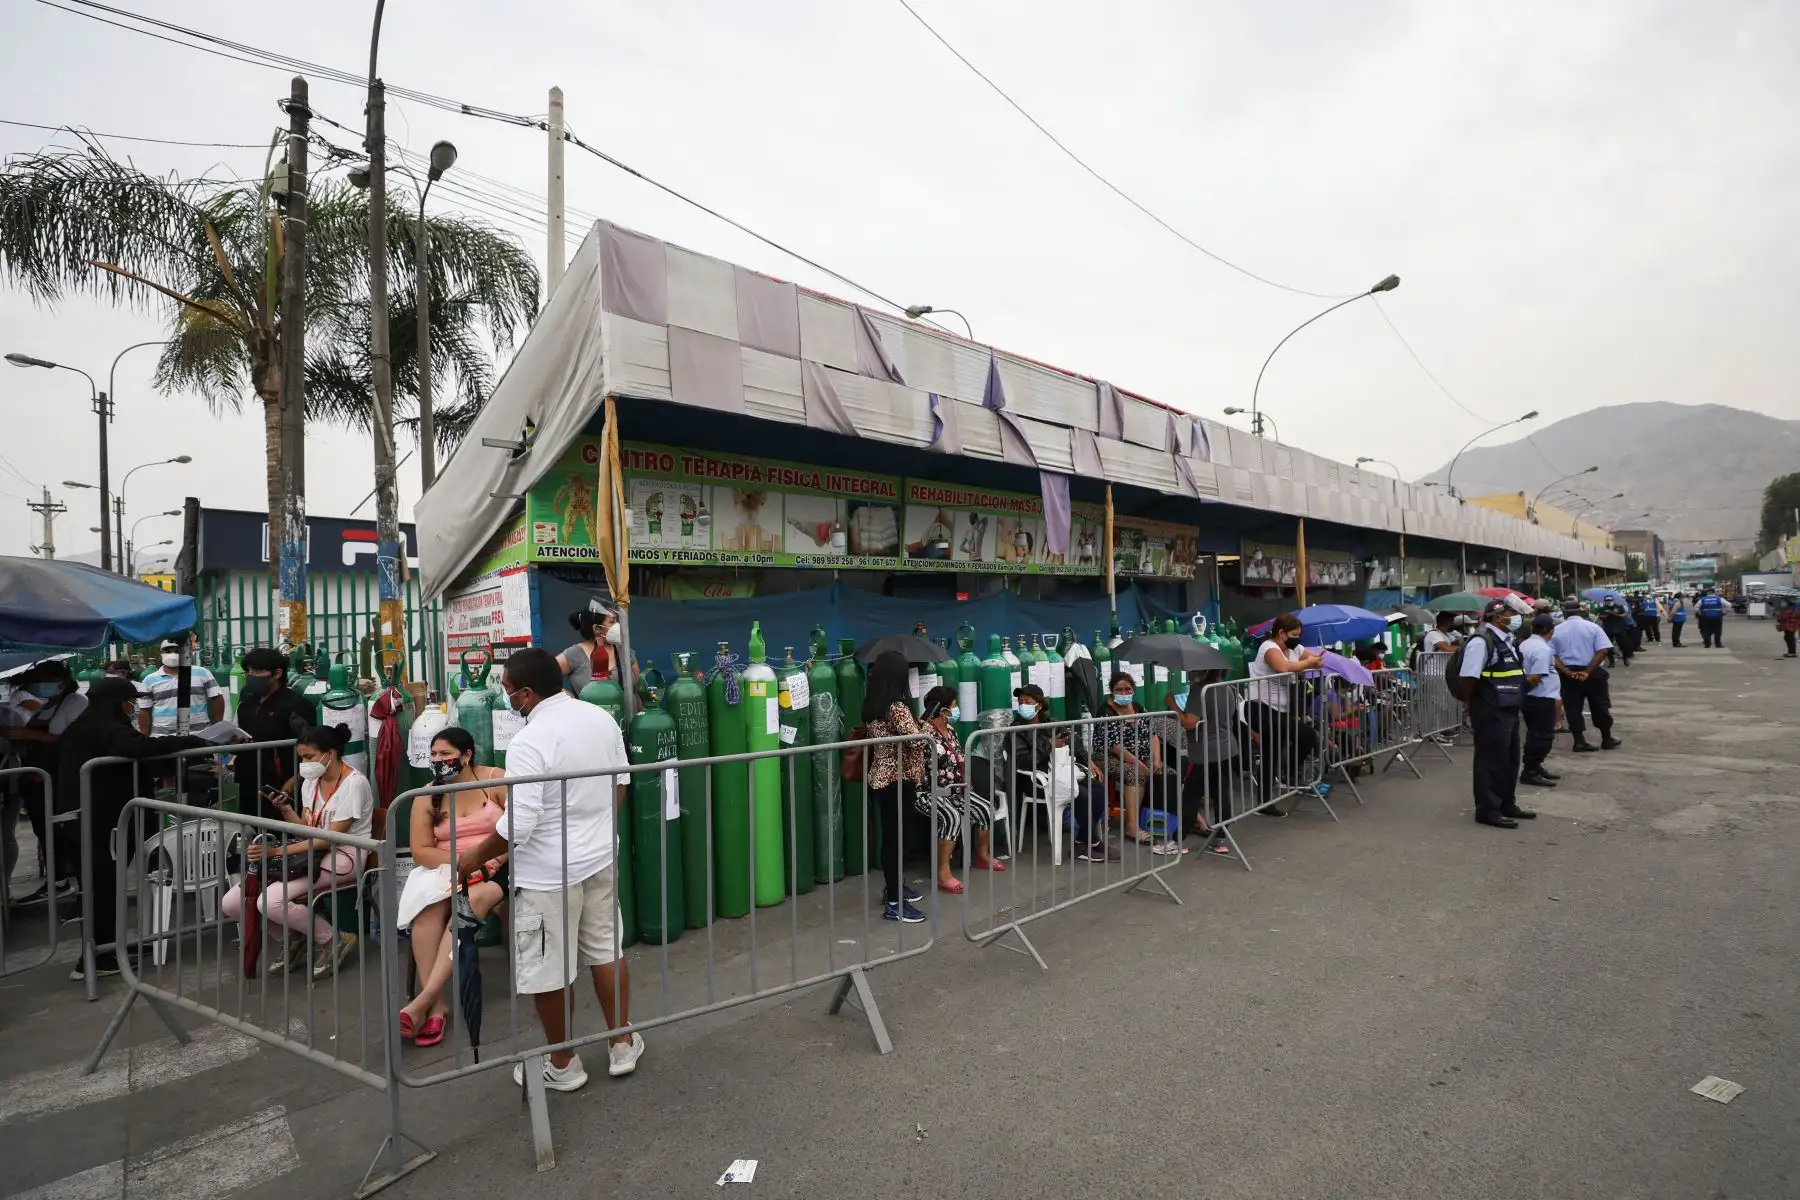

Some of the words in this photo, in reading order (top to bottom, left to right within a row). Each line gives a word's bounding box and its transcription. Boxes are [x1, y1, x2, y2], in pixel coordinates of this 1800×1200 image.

[581, 443, 676, 473] CNTRO
[680, 455, 762, 483] TERAPIA
[767, 464, 821, 489] FÍSICA
[825, 474, 897, 497] INTEGRAL
[910, 484, 1009, 509] REHABILITACION
[1010, 498, 1044, 515] MASAJ
[537, 544, 600, 559] ATENCIÓN:
[628, 549, 660, 560] INGOS
[663, 550, 669, 560] Y
[672, 551, 718, 562] FERIADOS
[751, 554, 774, 565] 10pm
[812, 556, 826, 565] 989
[827, 556, 841, 566] 952
[859, 557, 870, 566] 961
